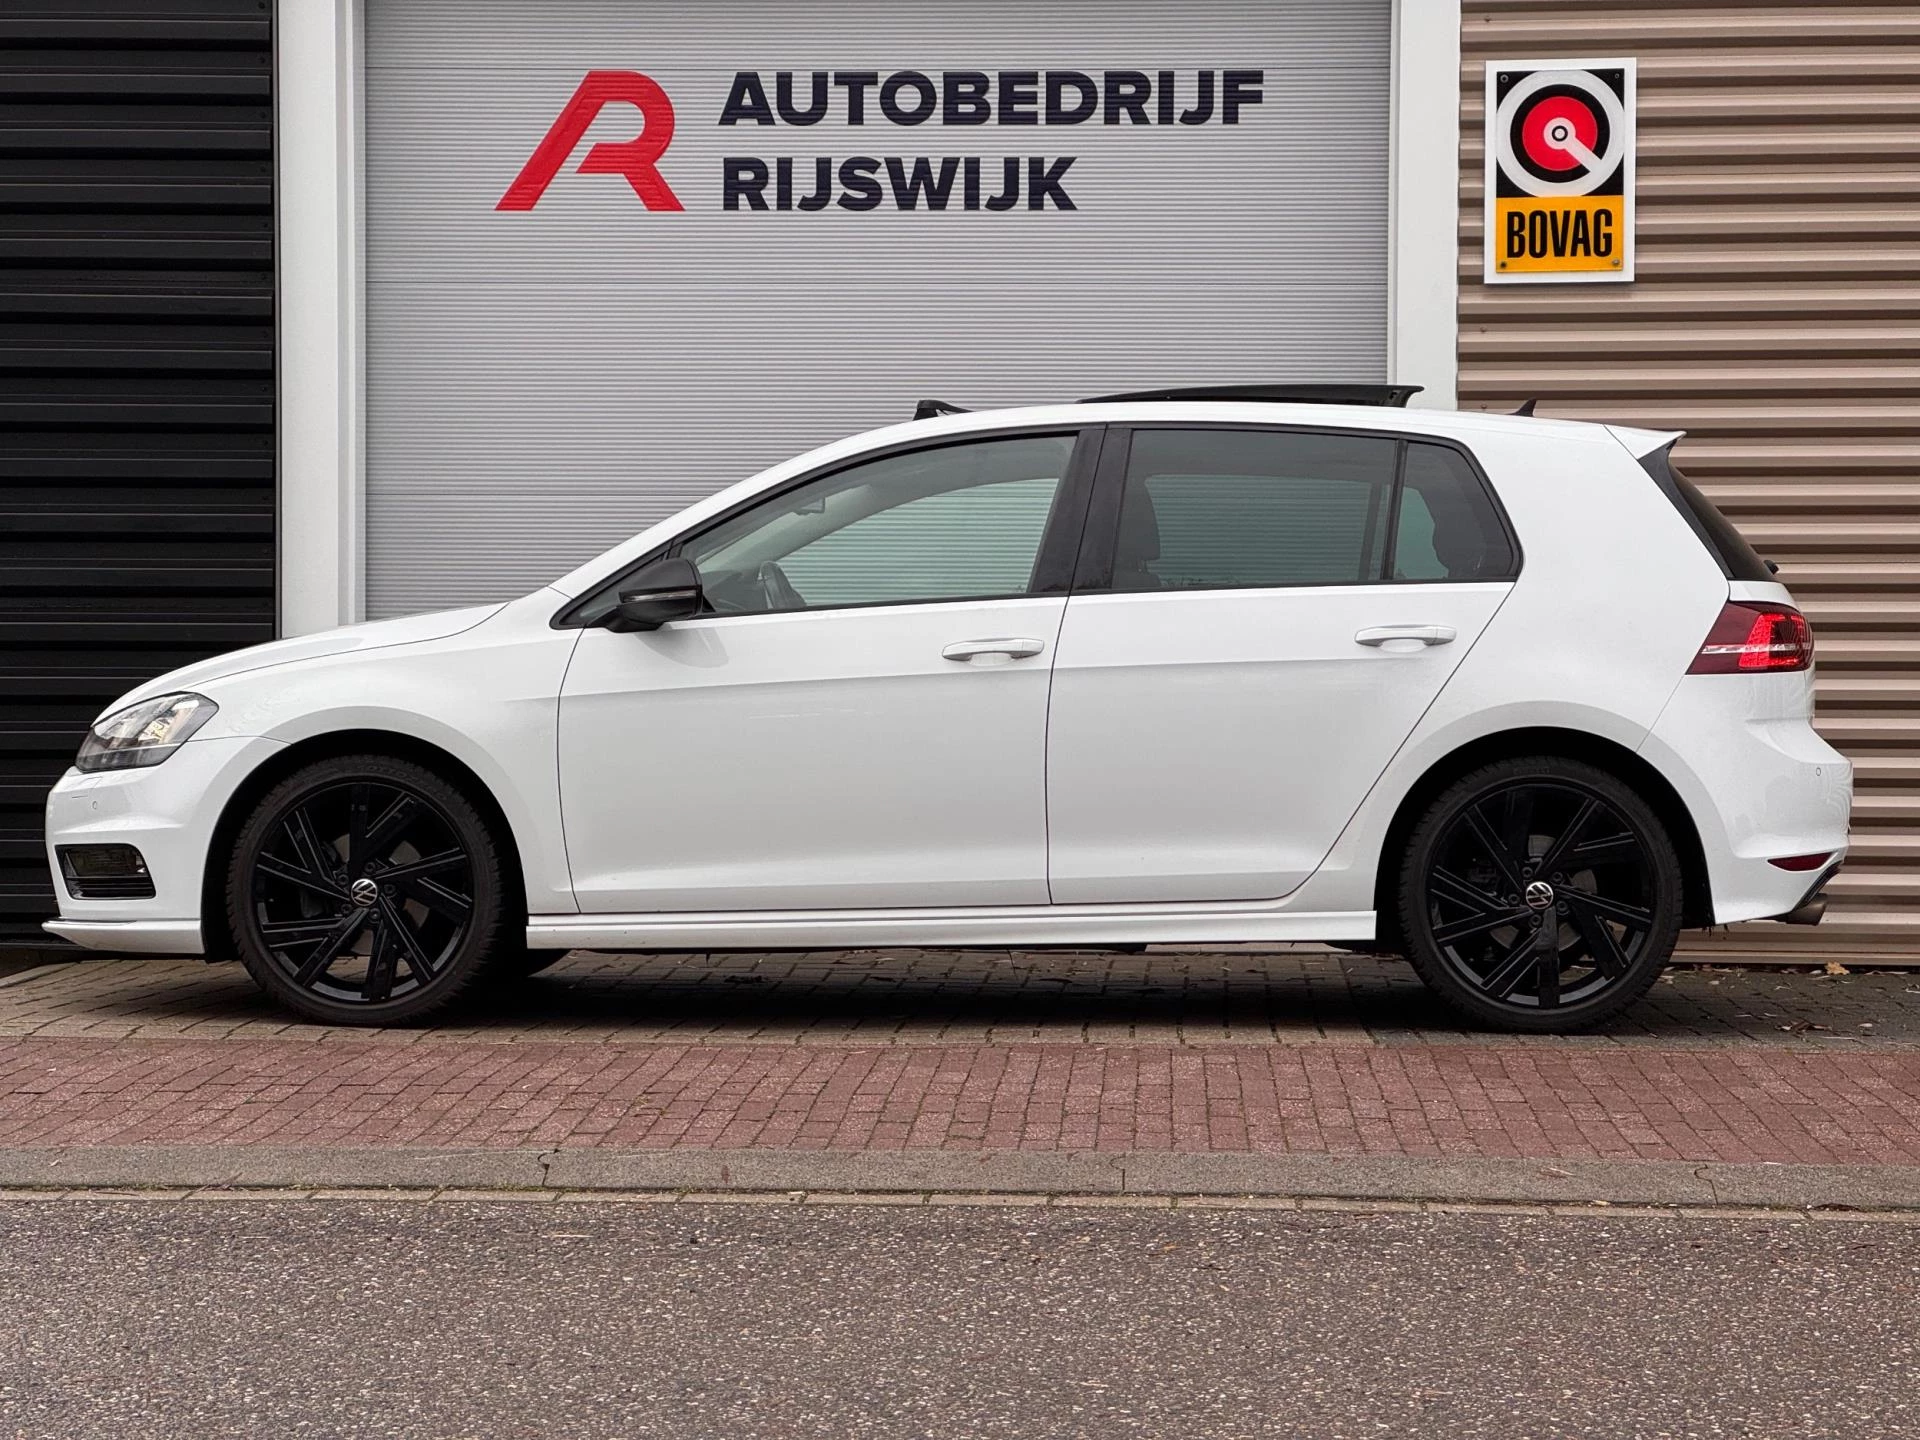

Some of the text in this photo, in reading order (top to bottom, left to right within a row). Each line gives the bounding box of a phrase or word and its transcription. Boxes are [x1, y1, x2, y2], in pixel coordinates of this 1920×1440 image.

[718, 70, 1264, 126] AUTOBEDRIJF
[722, 157, 1078, 211] RIJSWIJK
[1507, 208, 1613, 259] BOVAG
